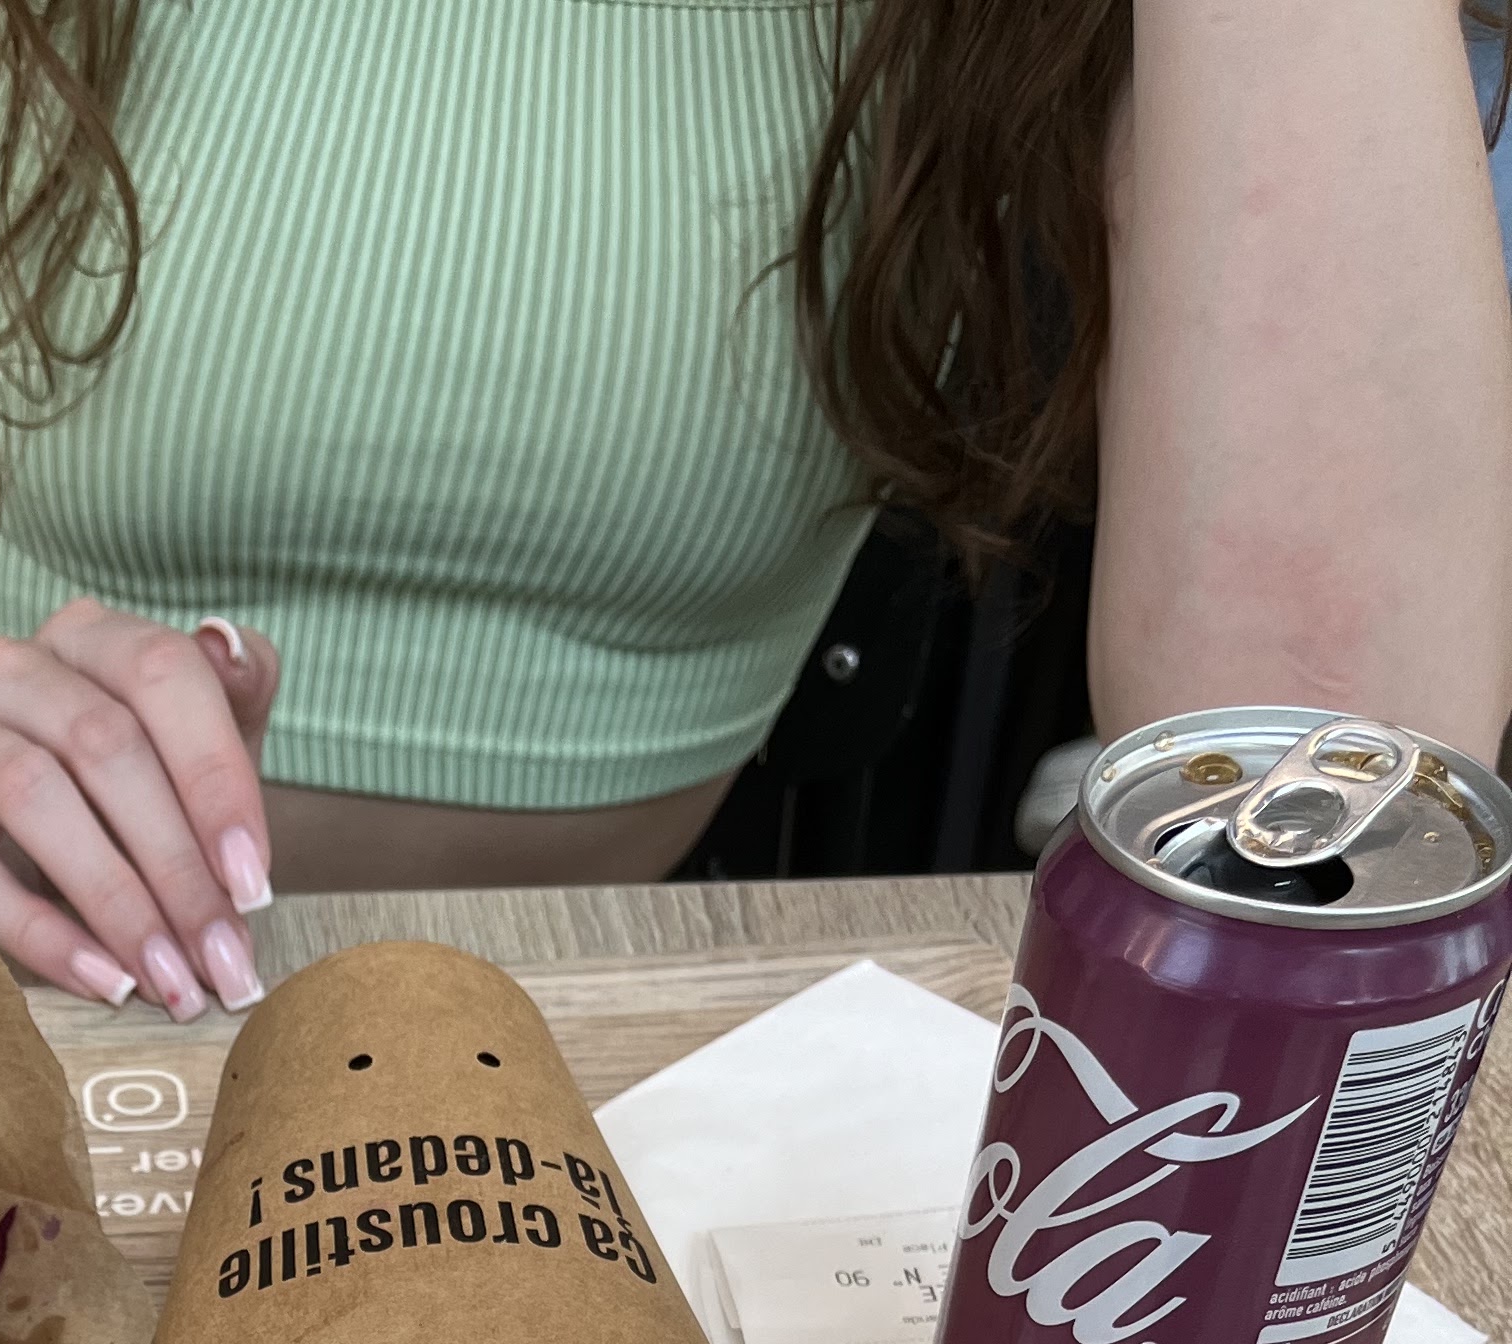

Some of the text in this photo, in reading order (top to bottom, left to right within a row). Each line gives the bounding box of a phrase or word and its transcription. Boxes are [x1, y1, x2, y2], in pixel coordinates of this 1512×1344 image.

[248, 1135, 623, 1228] là-dedans !
[217, 1199, 562, 1299] croustille
[834, 1270, 871, 1288] 90
[1269, 1284, 1327, 1305] acidifiant
[1264, 1303, 1304, 1321] arôme
